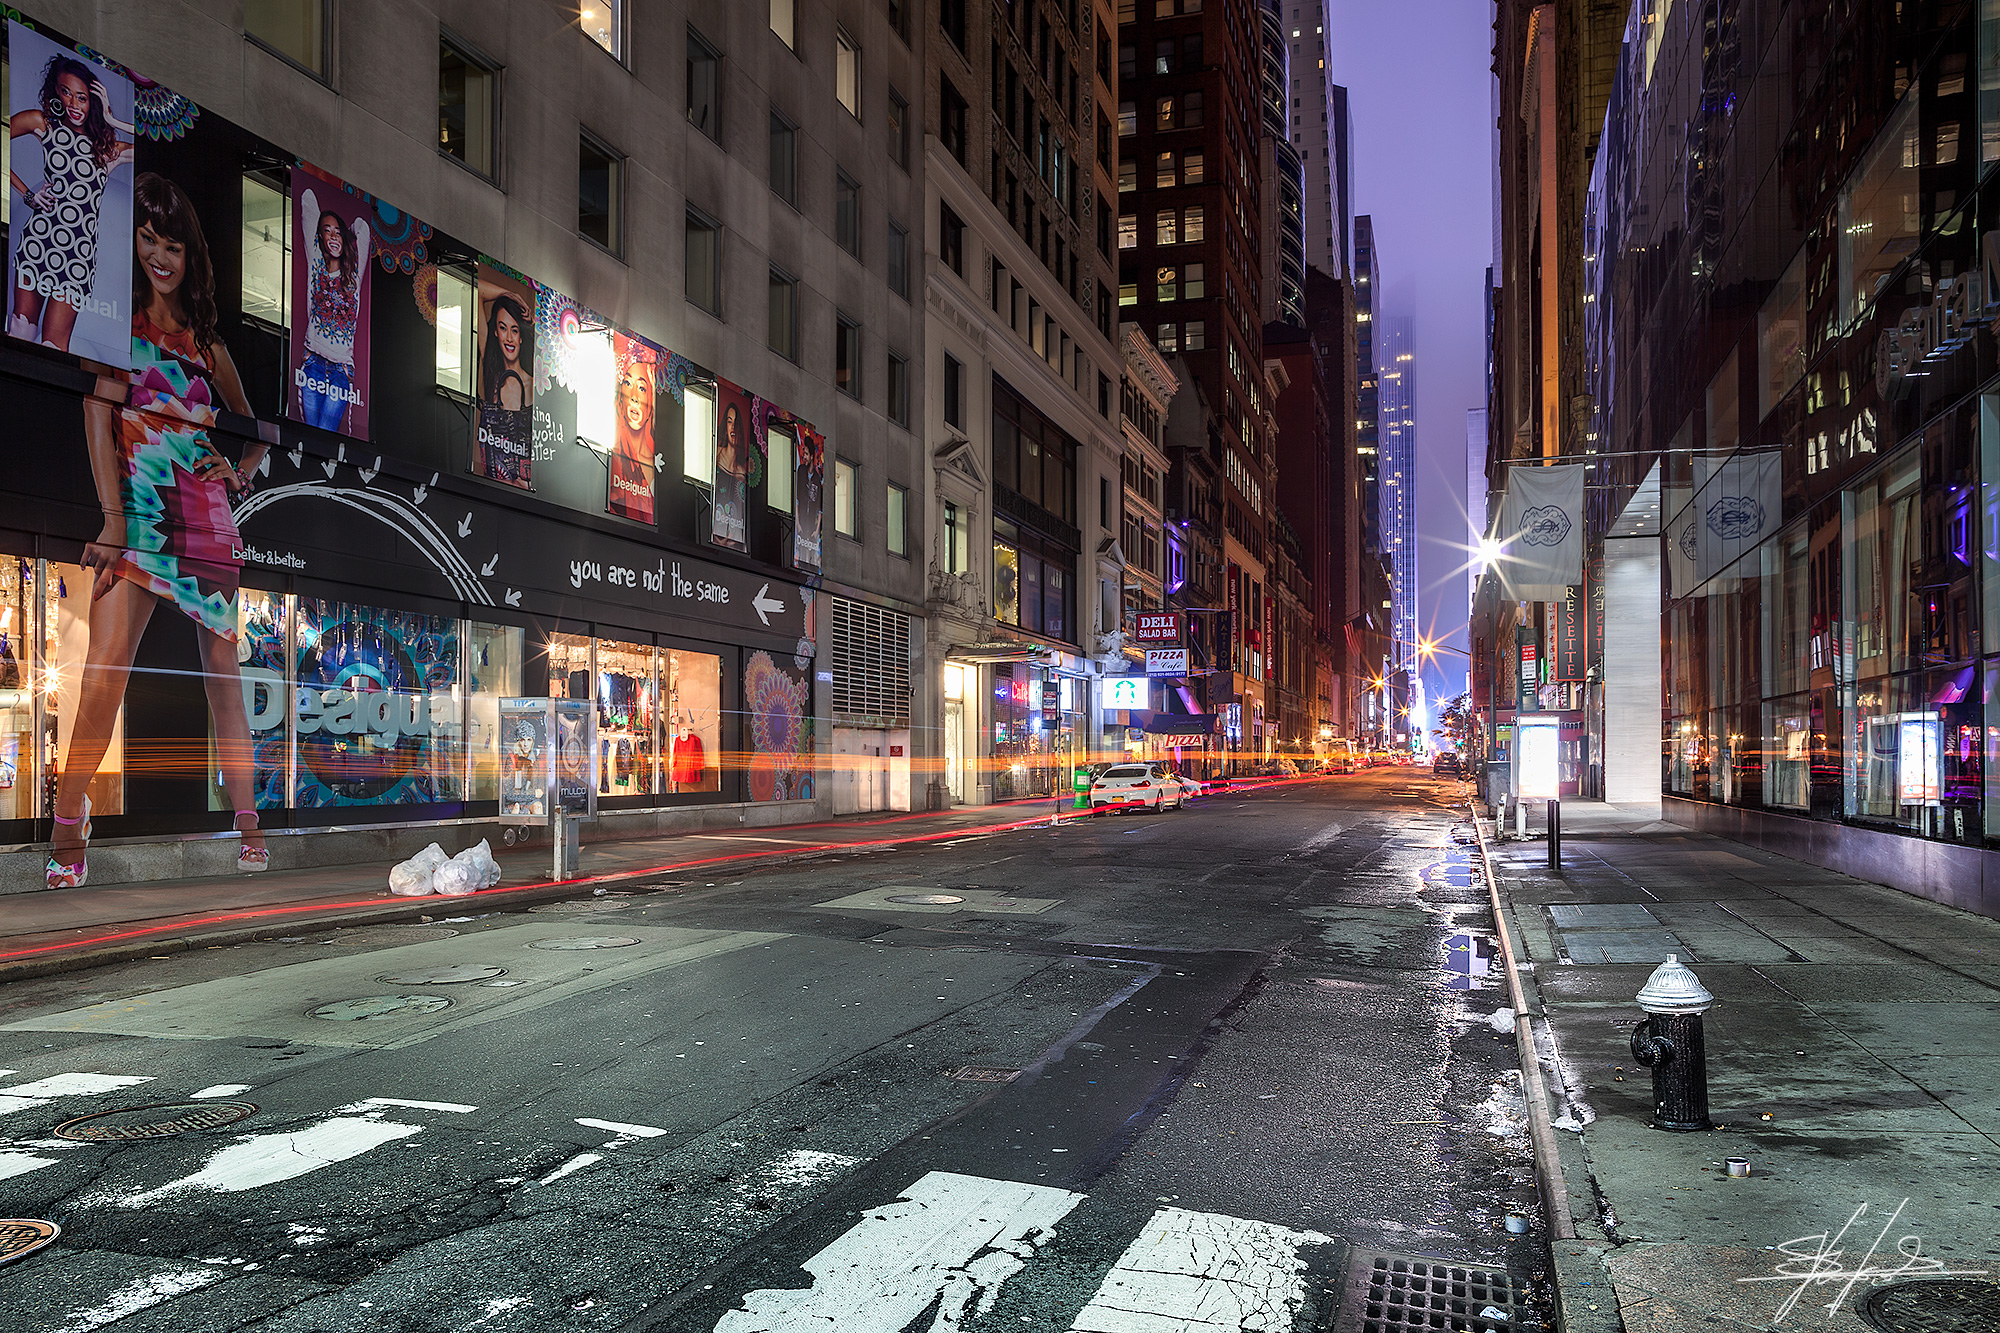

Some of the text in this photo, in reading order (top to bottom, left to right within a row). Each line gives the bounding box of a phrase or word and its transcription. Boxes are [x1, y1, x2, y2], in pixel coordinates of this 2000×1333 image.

[18, 267, 118, 320] Desigual
[1898, 271, 1970, 378] Safra
[295, 368, 361, 406] Desigual
[478, 427, 526, 456] Desigual
[531, 440, 557, 461] etter
[613, 474, 649, 497] Desigual
[715, 510, 744, 530] Desigual
[796, 534, 820, 551] Desigual
[231, 542, 307, 569] better&better
[570, 558, 730, 604] you are not the same
[1138, 628, 1177, 639] SALAD BAR
[1140, 616, 1175, 628] DELI
[1565, 586, 1577, 676] RESETTE
[1220, 615, 1228, 667] NATION
[1150, 650, 1184, 660] PIZZA
[513, 699, 536, 708] TITAN
[1166, 734, 1202, 747] PIZZA
